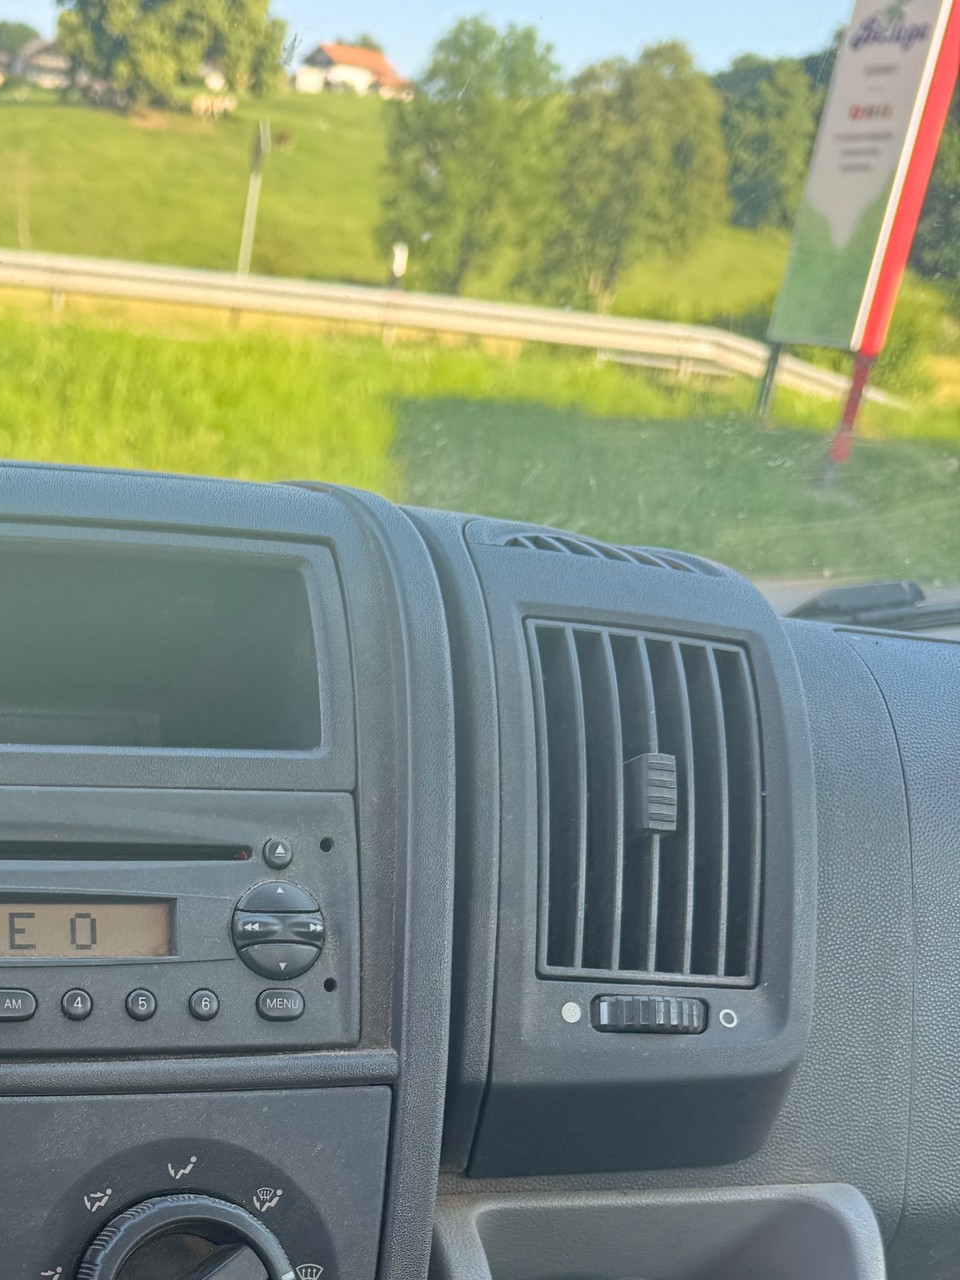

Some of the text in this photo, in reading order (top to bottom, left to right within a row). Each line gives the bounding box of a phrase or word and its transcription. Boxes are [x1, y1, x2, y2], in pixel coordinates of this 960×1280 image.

[4, 998, 22, 1010] AM
[73, 997, 83, 1010] 4
[138, 997, 147, 1011] 5
[201, 997, 210, 1011] 6
[266, 998, 300, 1010] MENU
